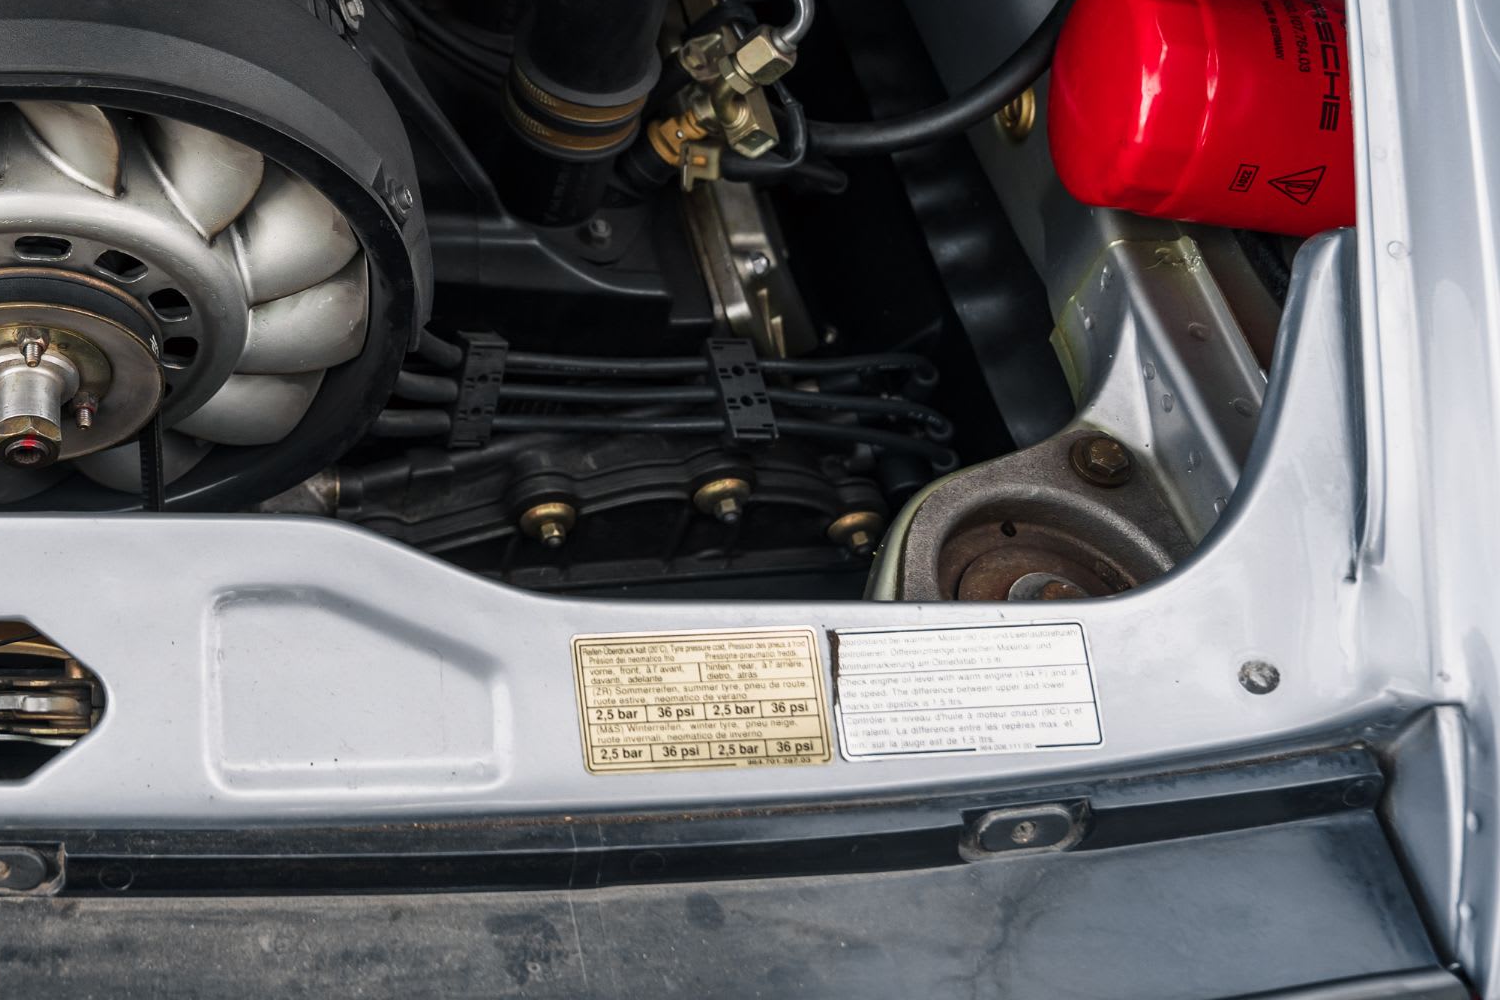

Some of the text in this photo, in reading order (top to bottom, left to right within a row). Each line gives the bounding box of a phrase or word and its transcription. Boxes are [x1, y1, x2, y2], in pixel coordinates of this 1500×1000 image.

[1270, 21, 1285, 61] GERMANY
[685, 643, 711, 653] pressure
[628, 675, 663, 684] adelante
[870, 677, 899, 687] engine
[914, 675, 935, 683] level
[938, 674, 956, 682] with
[958, 673, 981, 681] warm
[984, 672, 1013, 682] engine
[1051, 669, 1067, 677] and
[615, 685, 680, 695] Sommerreifen,
[683, 684, 718, 694] summer
[744, 681, 766, 690] pneu
[769, 680, 780, 689] de
[892, 687, 908, 696] The
[913, 685, 954, 696] difference
[956, 683, 992, 693] between
[995, 682, 1021, 693] upper
[1023, 682, 1040, 690] and
[1042, 682, 1065, 690] lower
[593, 696, 617, 705] ruote
[654, 693, 700, 703] neomatico
[703, 692, 715, 701] de
[716, 692, 748, 700] verano
[886, 700, 919, 710] dipstick
[595, 700, 809, 722] 2,5 bar 36 psi 2,5 bar 36 psi
[901, 714, 932, 723] niveau
[976, 710, 1008, 719] moteur
[1010, 708, 1038, 718] chaud
[690, 721, 717, 730] winter
[745, 719, 768, 728] pneu
[896, 727, 908, 736] La
[958, 723, 984, 733] entre
[986, 722, 999, 732] les
[597, 735, 620, 744] ruote
[667, 732, 713, 741] neomatico
[715, 731, 728, 740] de
[729, 730, 763, 739] inverno
[871, 740, 886, 749] sur
[889, 739, 899, 748] la
[900, 738, 926, 749] jauge
[928, 737, 943, 746] est
[946, 736, 957, 746] de
[600, 740, 814, 761] 2,5 bar 36 psi 2,5 bar 36 psi
